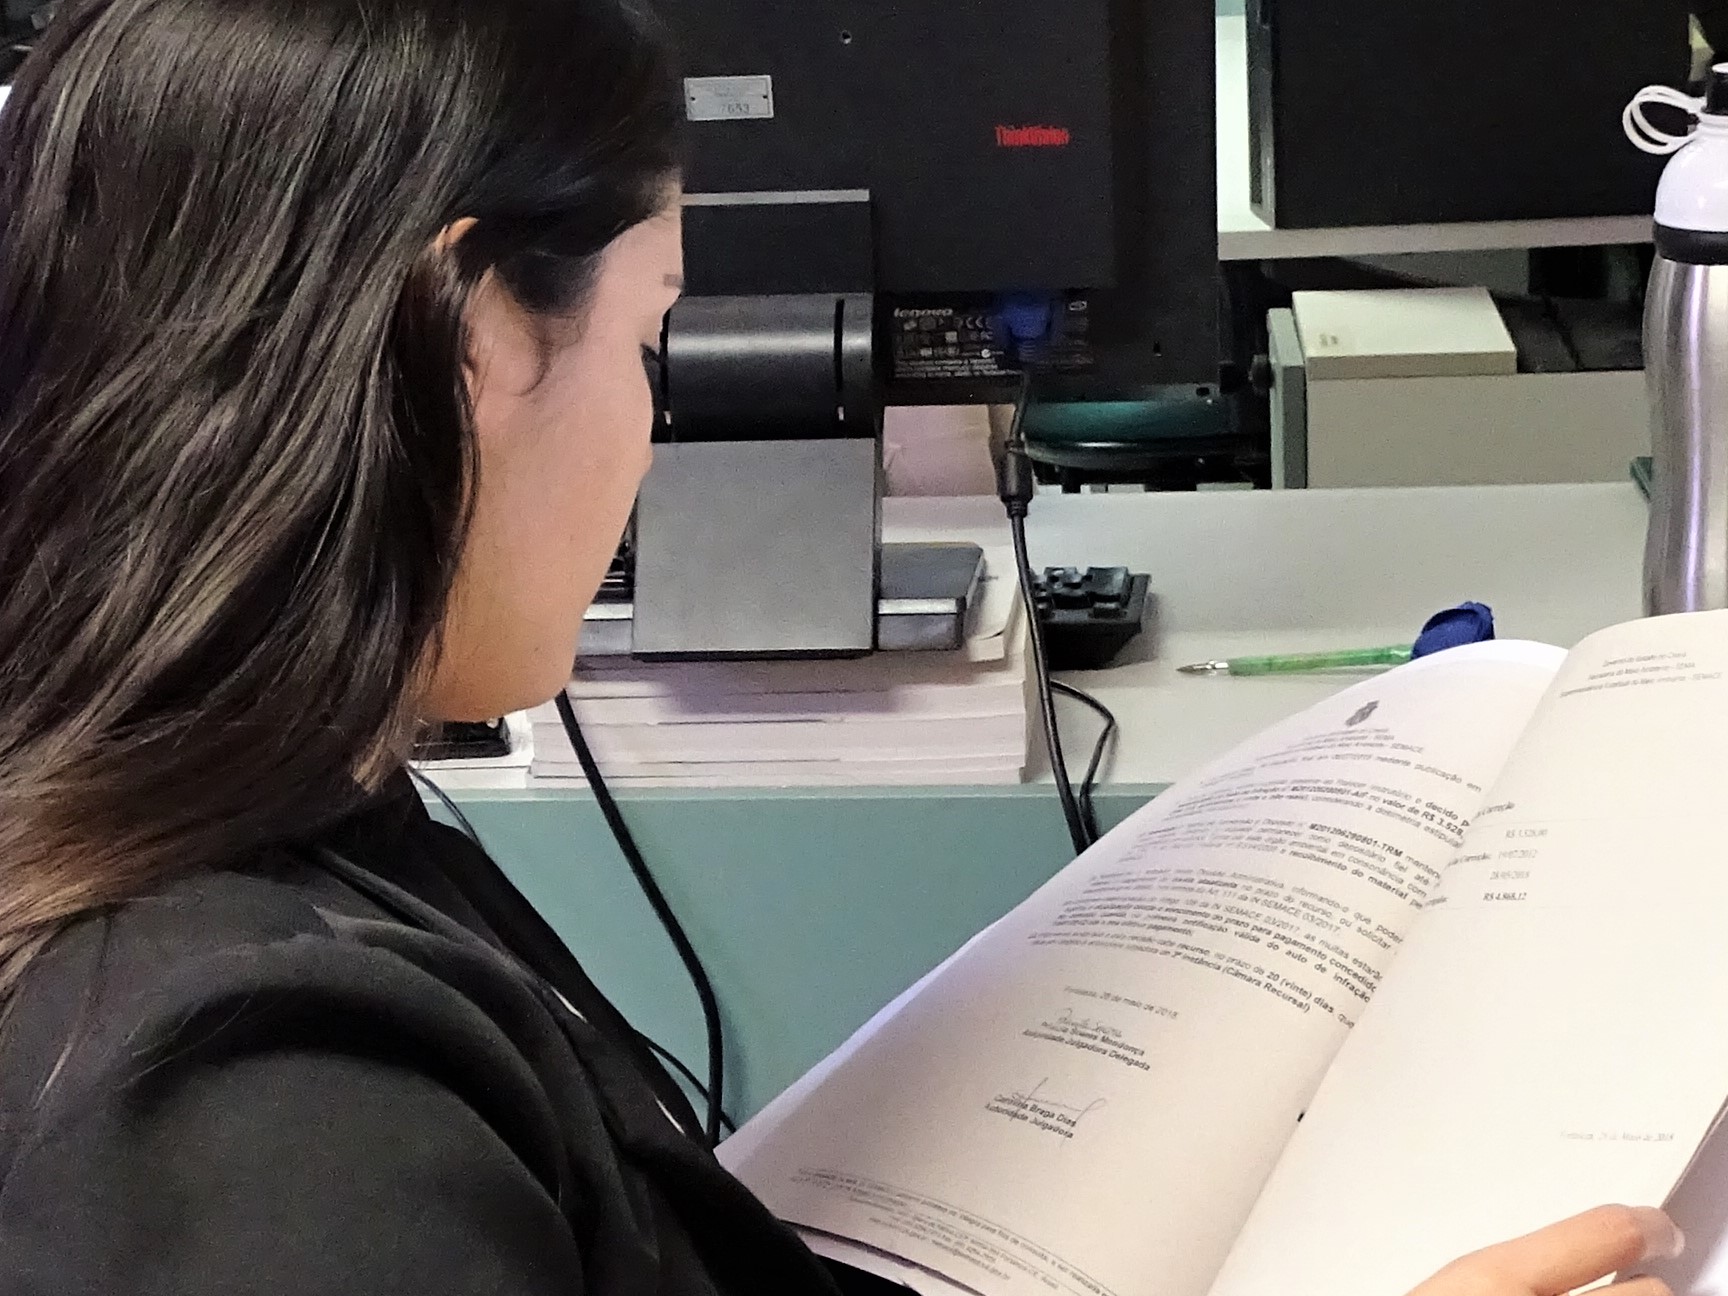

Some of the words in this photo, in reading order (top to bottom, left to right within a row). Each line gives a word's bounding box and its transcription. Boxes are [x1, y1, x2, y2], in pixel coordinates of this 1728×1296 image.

[894, 308, 953, 317] lenovo
[1466, 782, 1481, 793] em
[1382, 799, 1406, 809] valor
[1407, 806, 1420, 815] de
[1422, 811, 1435, 822] R$
[1426, 801, 1458, 821] decido
[1351, 868, 1364, 879] do
[1368, 876, 1408, 901] material
[1407, 885, 1428, 900] com
[1259, 897, 1301, 919] SEMACE
[1352, 910, 1372, 926] que
[1251, 920, 1272, 934] para
[1273, 930, 1327, 962] pagamento
[1266, 942, 1279, 950] do
[1284, 948, 1309, 965] auto
[1313, 962, 1327, 974] de
[1332, 971, 1371, 1004] infração
[1222, 964, 1263, 990] (Câmara
[1263, 981, 1312, 1014] Recursal)
[1266, 971, 1280, 983] 20
[1281, 976, 1313, 1001] (vinte)
